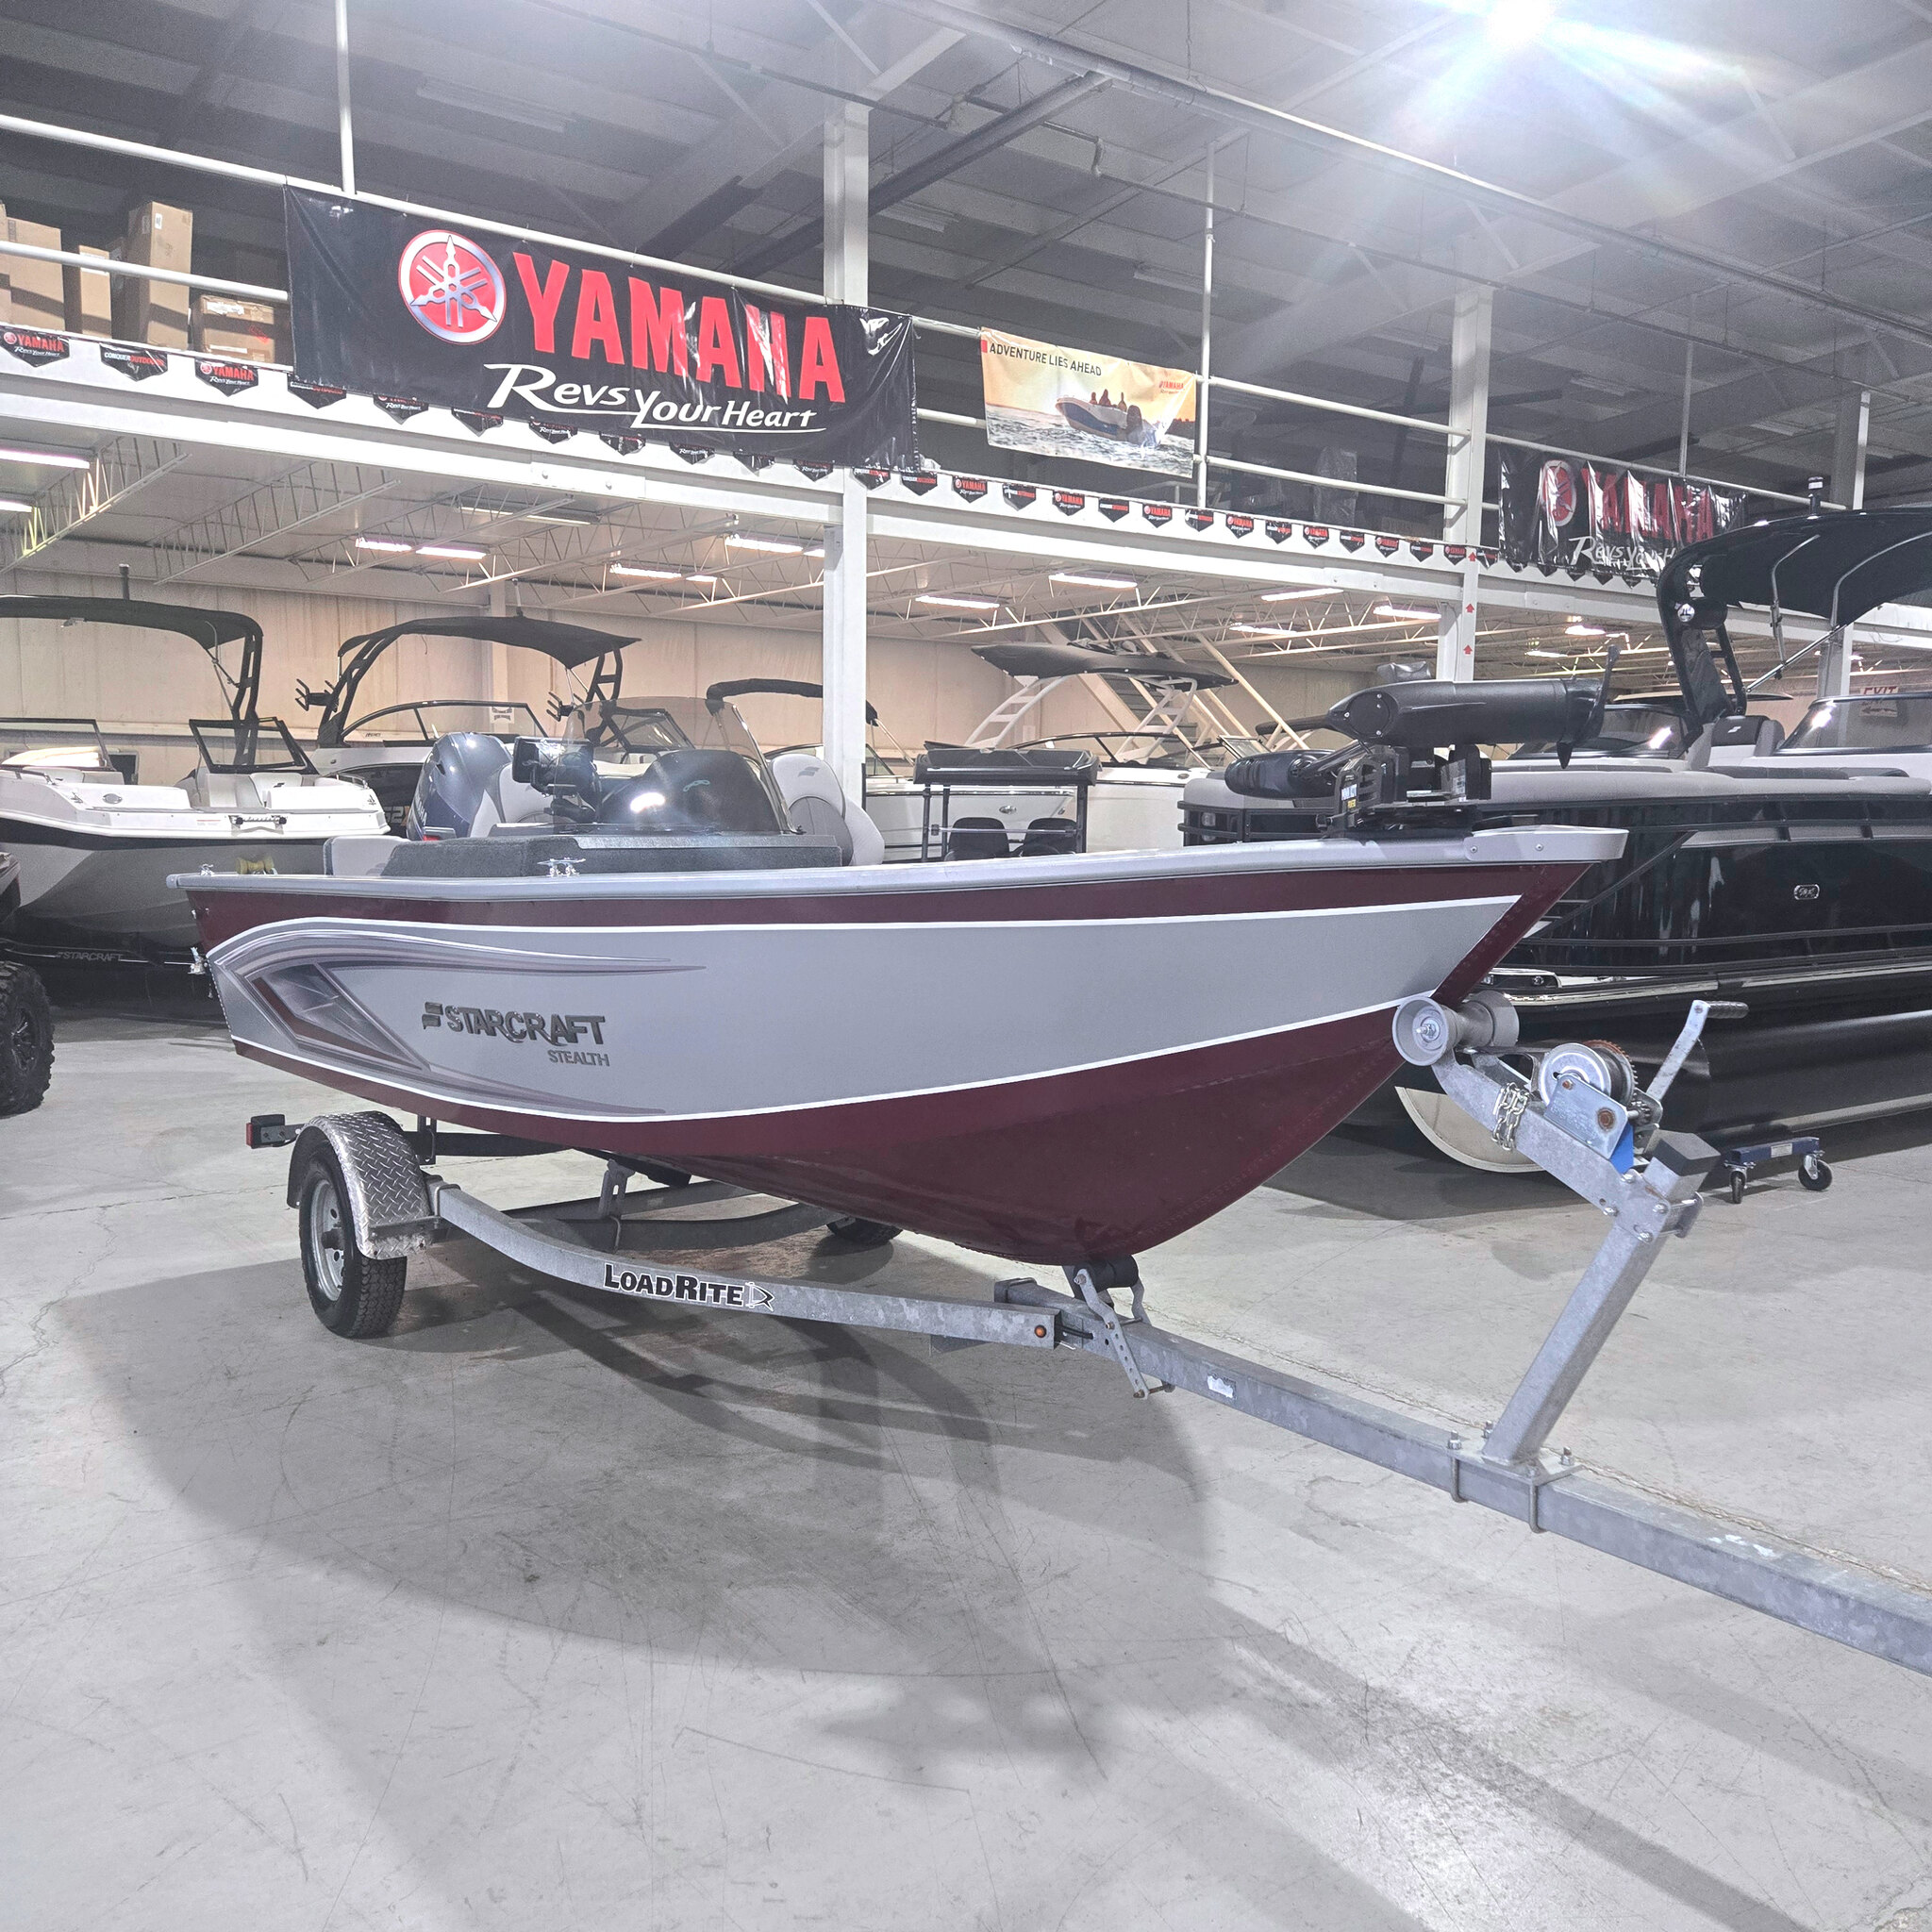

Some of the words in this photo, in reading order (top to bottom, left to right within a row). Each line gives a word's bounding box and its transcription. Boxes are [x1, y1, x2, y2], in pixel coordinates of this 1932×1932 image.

[513, 251, 846, 403] YAMAHA
[17, 334, 65, 353] YAMAHA
[990, 342, 1047, 364] ADVENTURE
[1048, 354, 1068, 369] LIES
[1070, 360, 1102, 376] AHEAD
[212, 365, 255, 381] YAMAHA
[482, 363, 641, 414] Revs
[629, 388, 722, 429] Your
[723, 400, 817, 427] Heart
[962, 480, 987, 491] YAMAHA
[62, 951, 124, 962] STARCRAFT
[444, 1005, 606, 1046] STARCRAFT
[547, 1049, 610, 1067] STEALTH
[604, 1263, 744, 1307] LOADRITE
